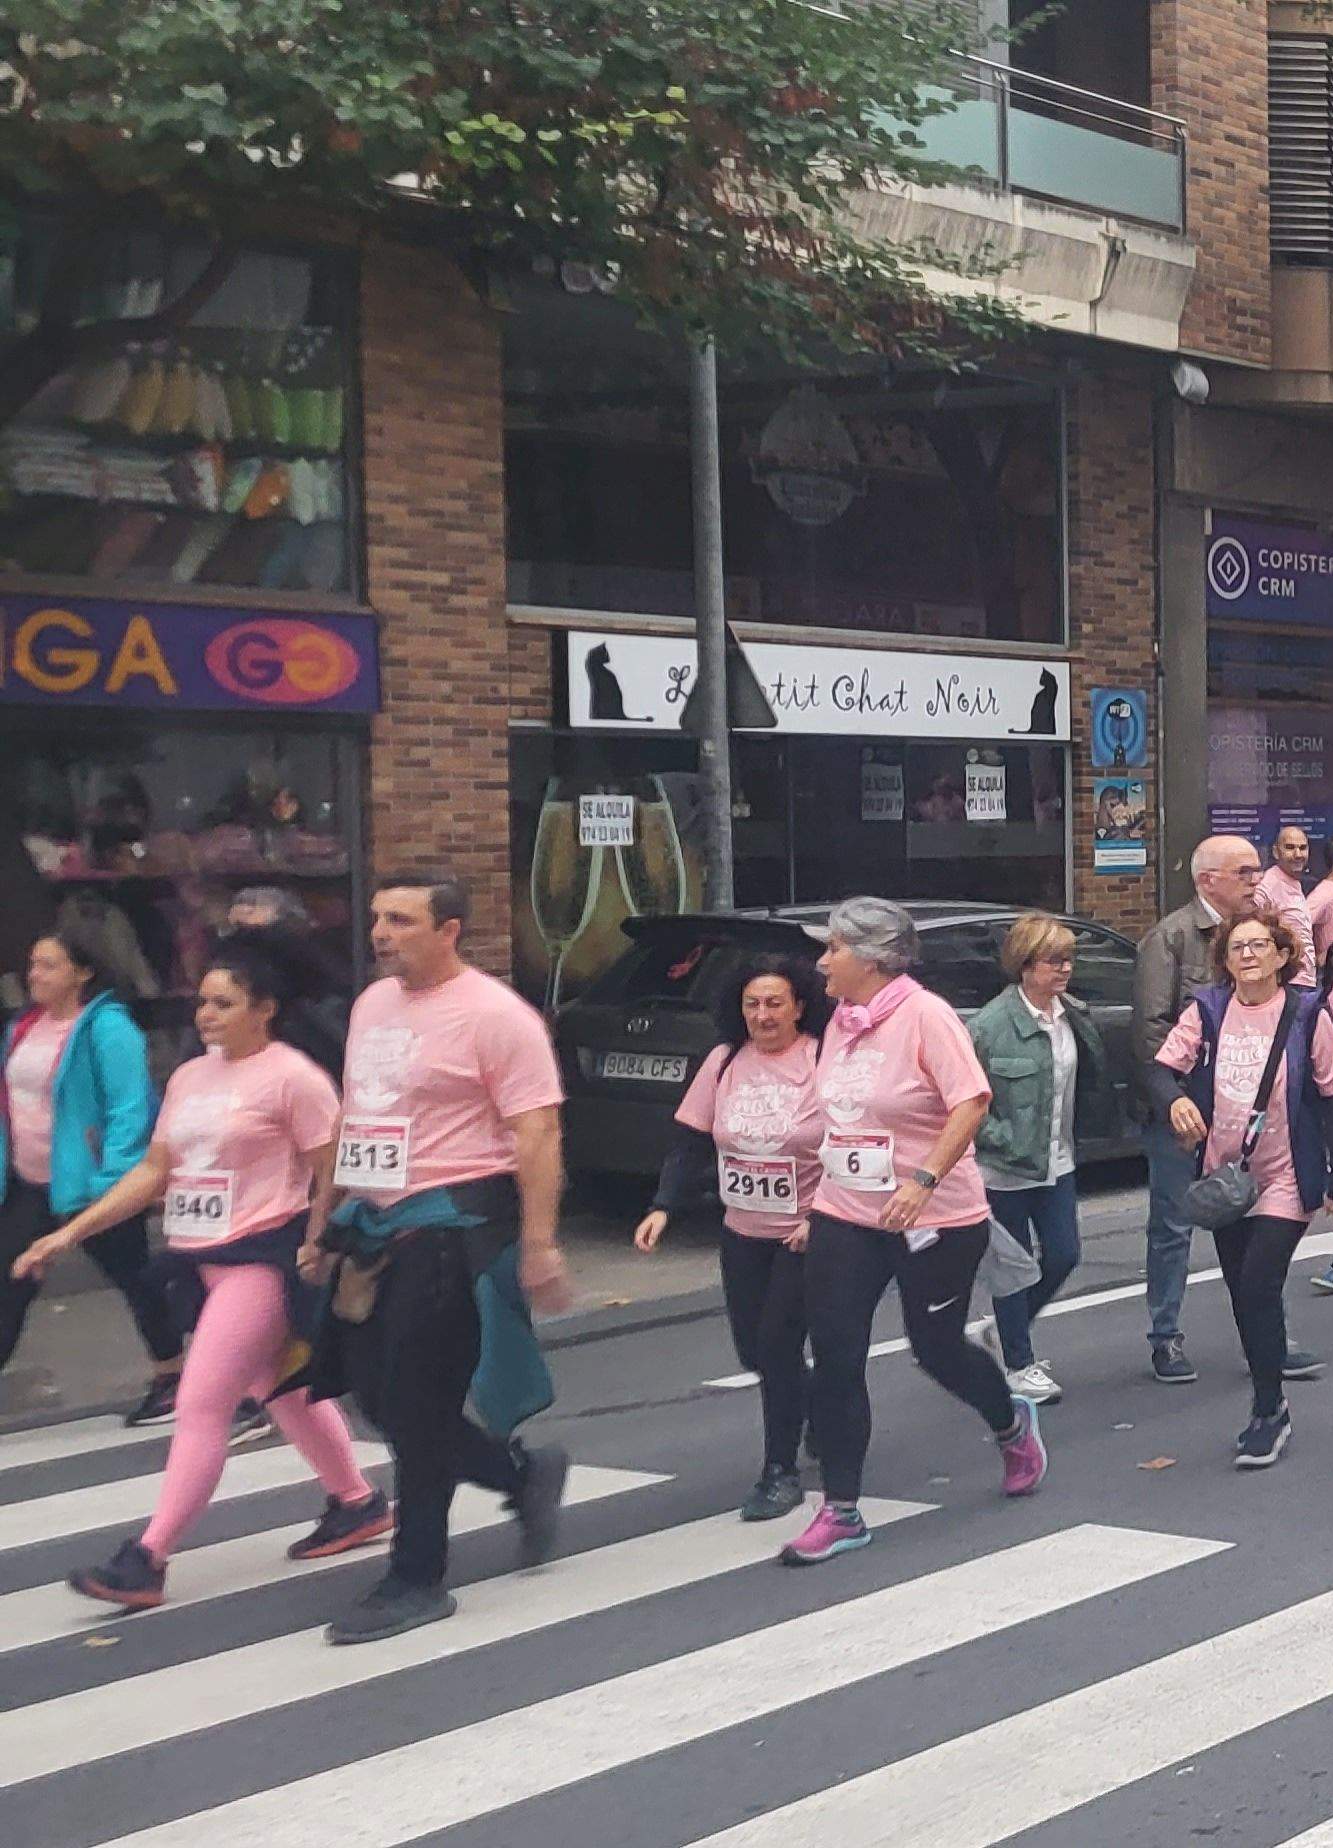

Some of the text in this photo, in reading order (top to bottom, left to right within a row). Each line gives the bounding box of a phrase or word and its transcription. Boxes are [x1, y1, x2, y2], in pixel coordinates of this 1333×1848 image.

[1258, 577, 1295, 598] CRM
[0, 608, 178, 695] GA
[665, 665, 692, 704] L
[832, 667, 910, 714] Chat
[926, 673, 1001, 716] Noir
[1291, 736, 1324, 752] CRM
[583, 801, 631, 819] SE ALQUILA
[651, 1058, 685, 1081] CFS
[340, 1142, 400, 1172] 2513
[847, 1150, 860, 1174] 6
[727, 1171, 791, 1199] 2916
